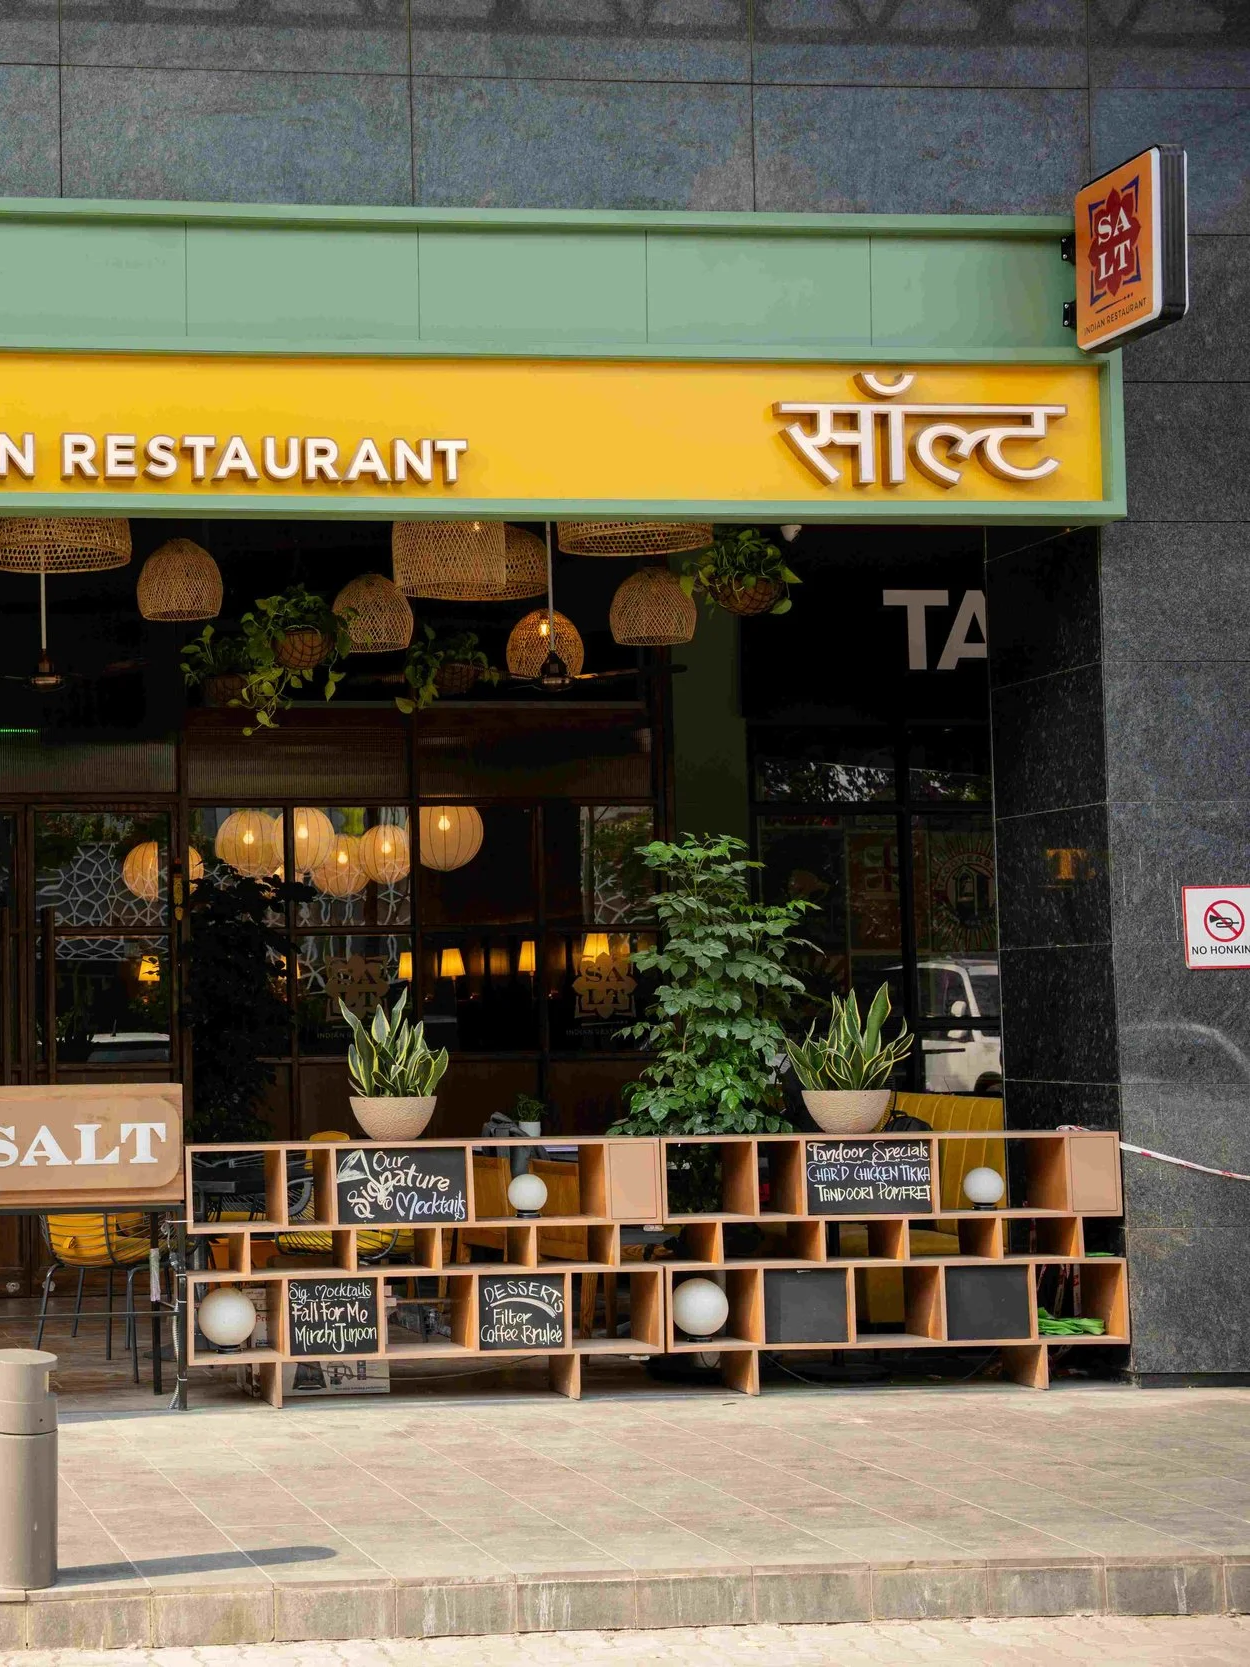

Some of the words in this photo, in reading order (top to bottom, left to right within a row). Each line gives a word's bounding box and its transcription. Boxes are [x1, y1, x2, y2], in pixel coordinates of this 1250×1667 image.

[1097, 207, 1131, 245] SA
[1098, 239, 1131, 281] LT
[1083, 318, 1106, 337] INDIAN
[1106, 297, 1147, 324] RESTAURANT
[772, 371, 1069, 489] सॉल्ट
[59, 433, 469, 484] RESTAURANT
[882, 589, 988, 671] TA
[1192, 945, 1207, 955] NO
[1210, 945, 1250, 955] HONKIN
[372, 1150, 409, 1172] Our
[807, 1142, 869, 1162] Tandoor
[872, 1141, 928, 1166] Specials
[853, 1165, 899, 1182] CHICKEN
[900, 1164, 930, 1182] TIKKA
[814, 1184, 874, 1202] TANDOORI
[876, 1181, 930, 1202] POMFRET
[395, 1190, 467, 1220] Mocktails
[315, 1281, 372, 1299] Mocktails
[484, 1280, 565, 1313] DESSERTS
[292, 1302, 318, 1323] Fall
[319, 1301, 345, 1321] For
[347, 1301, 368, 1324] Me
[493, 1308, 532, 1326] Filter
[480, 1324, 519, 1343] Coffee
